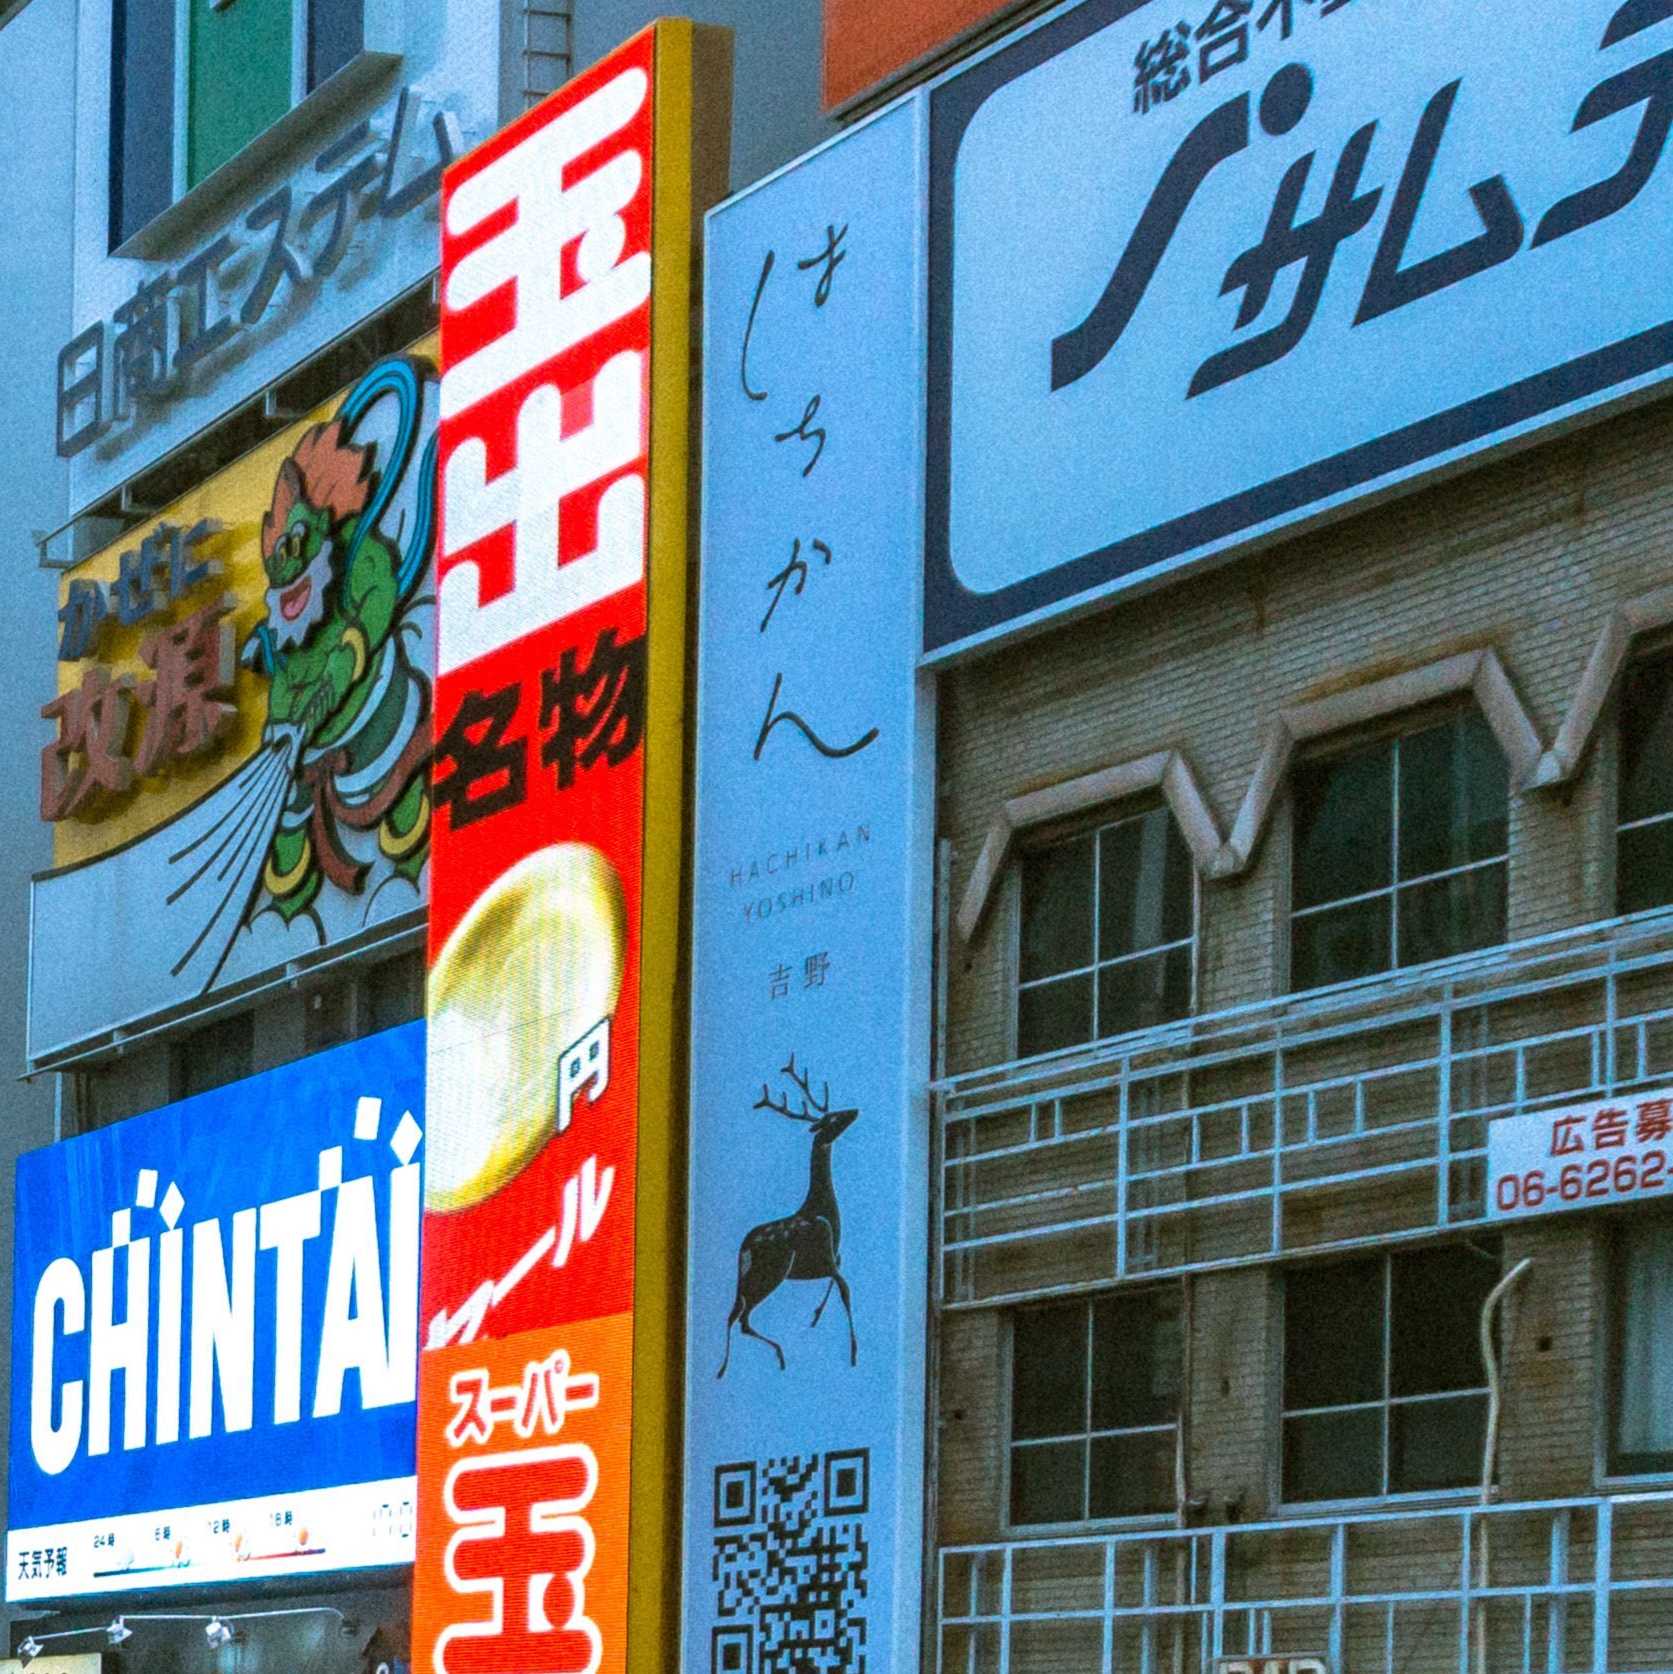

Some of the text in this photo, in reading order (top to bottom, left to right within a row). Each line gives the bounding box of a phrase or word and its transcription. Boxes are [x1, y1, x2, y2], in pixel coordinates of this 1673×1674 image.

[57, 88, 453, 457] 日商エステム
[440, 66, 651, 677] 玉出
[58, 517, 227, 658] かぜに
[40, 594, 237, 822] 改源
[429, 627, 647, 830] 名物
[728, 820, 875, 886] HACHIKAN
[742, 868, 856, 922] YOSHINO
[768, 950, 833, 1000] 吉野
[1550, 1098, 1673, 1158] 広告募
[31, 1096, 423, 1476] CHINTAI
[447, 1347, 599, 1448] スーパー
[18, 1545, 68, 1580] 天気予報
